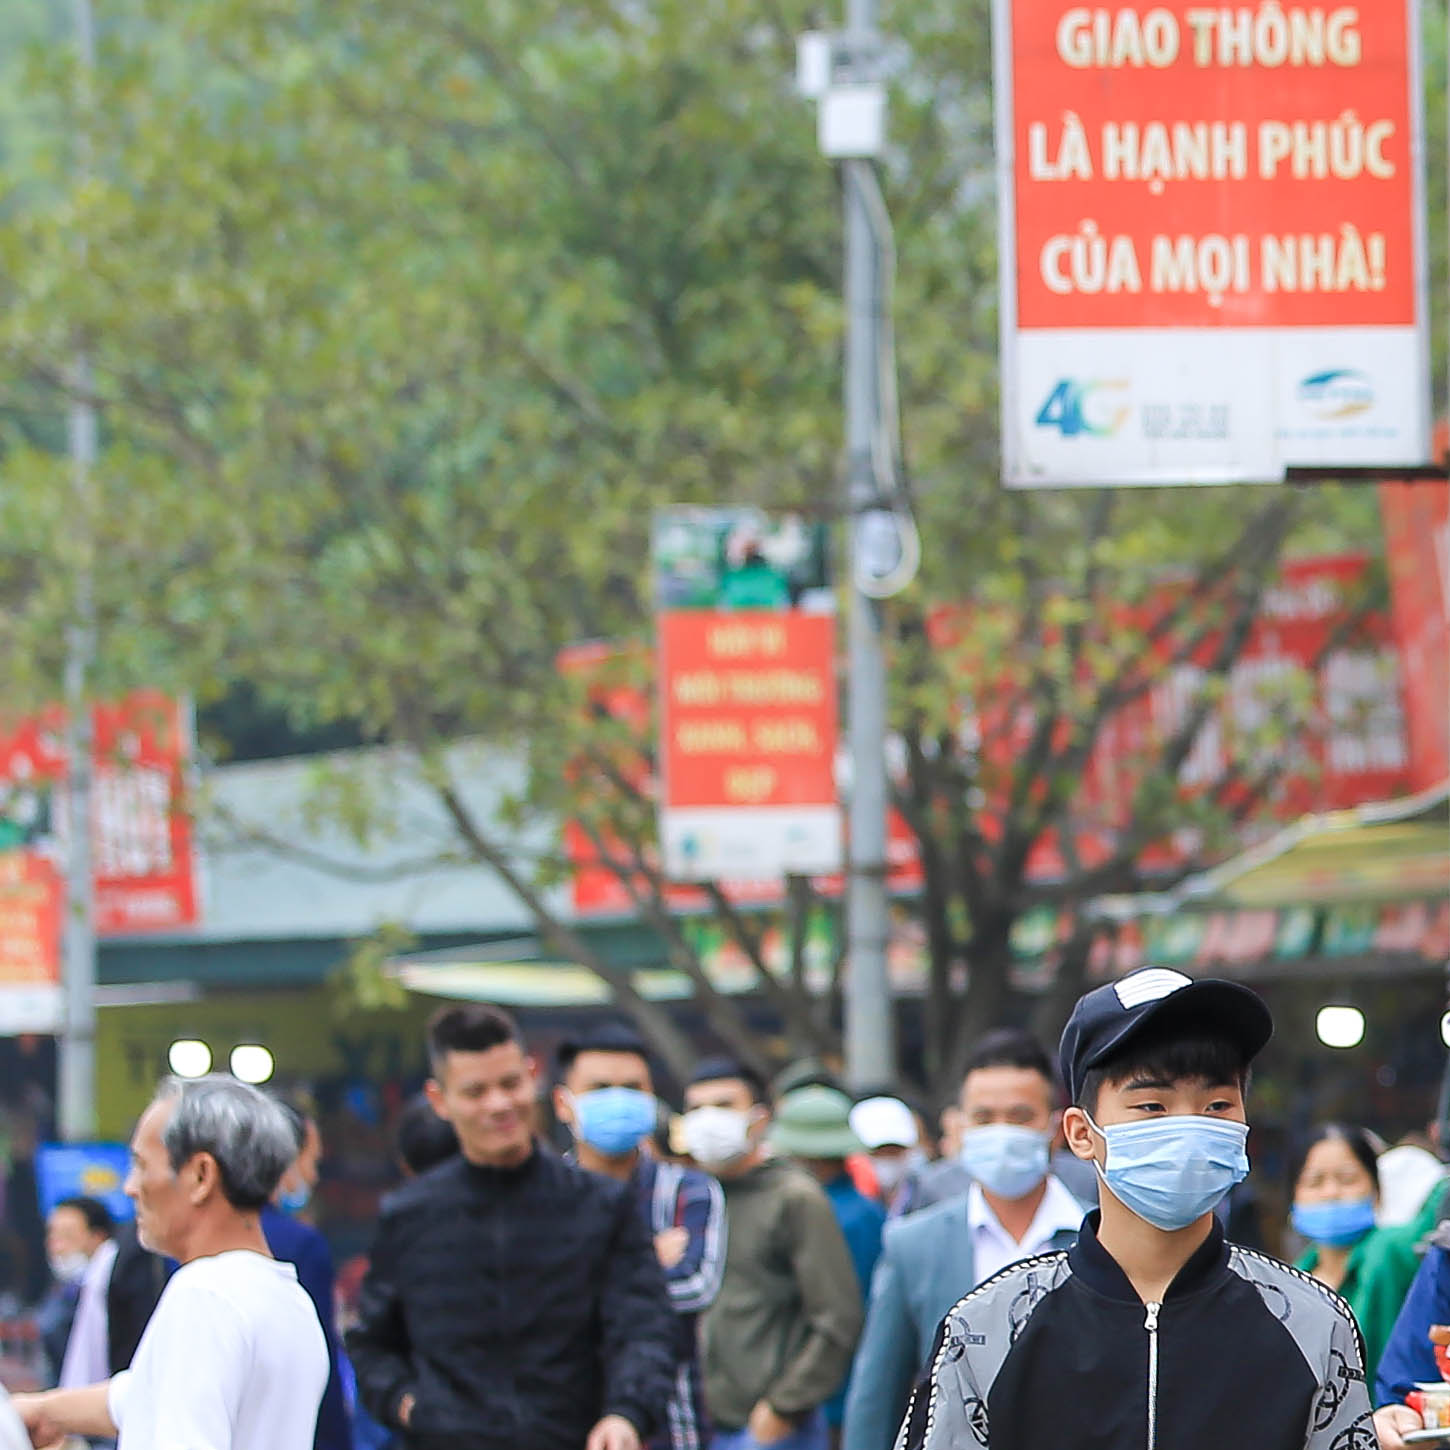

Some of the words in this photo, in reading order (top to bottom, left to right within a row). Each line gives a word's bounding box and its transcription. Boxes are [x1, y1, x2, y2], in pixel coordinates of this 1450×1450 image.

[1057, 8, 1179, 68] GIAO
[1187, 0, 1362, 68] THÔNG
[1028, 110, 1093, 180] LÀ
[1102, 121, 1246, 194] HẠNH
[1258, 110, 1396, 180] PHÚC
[1040, 219, 1141, 294] CỦA
[1150, 235, 1248, 308] MỌI
[1261, 223, 1386, 292] NHÀ!
[1035, 376, 1134, 438] 4G
